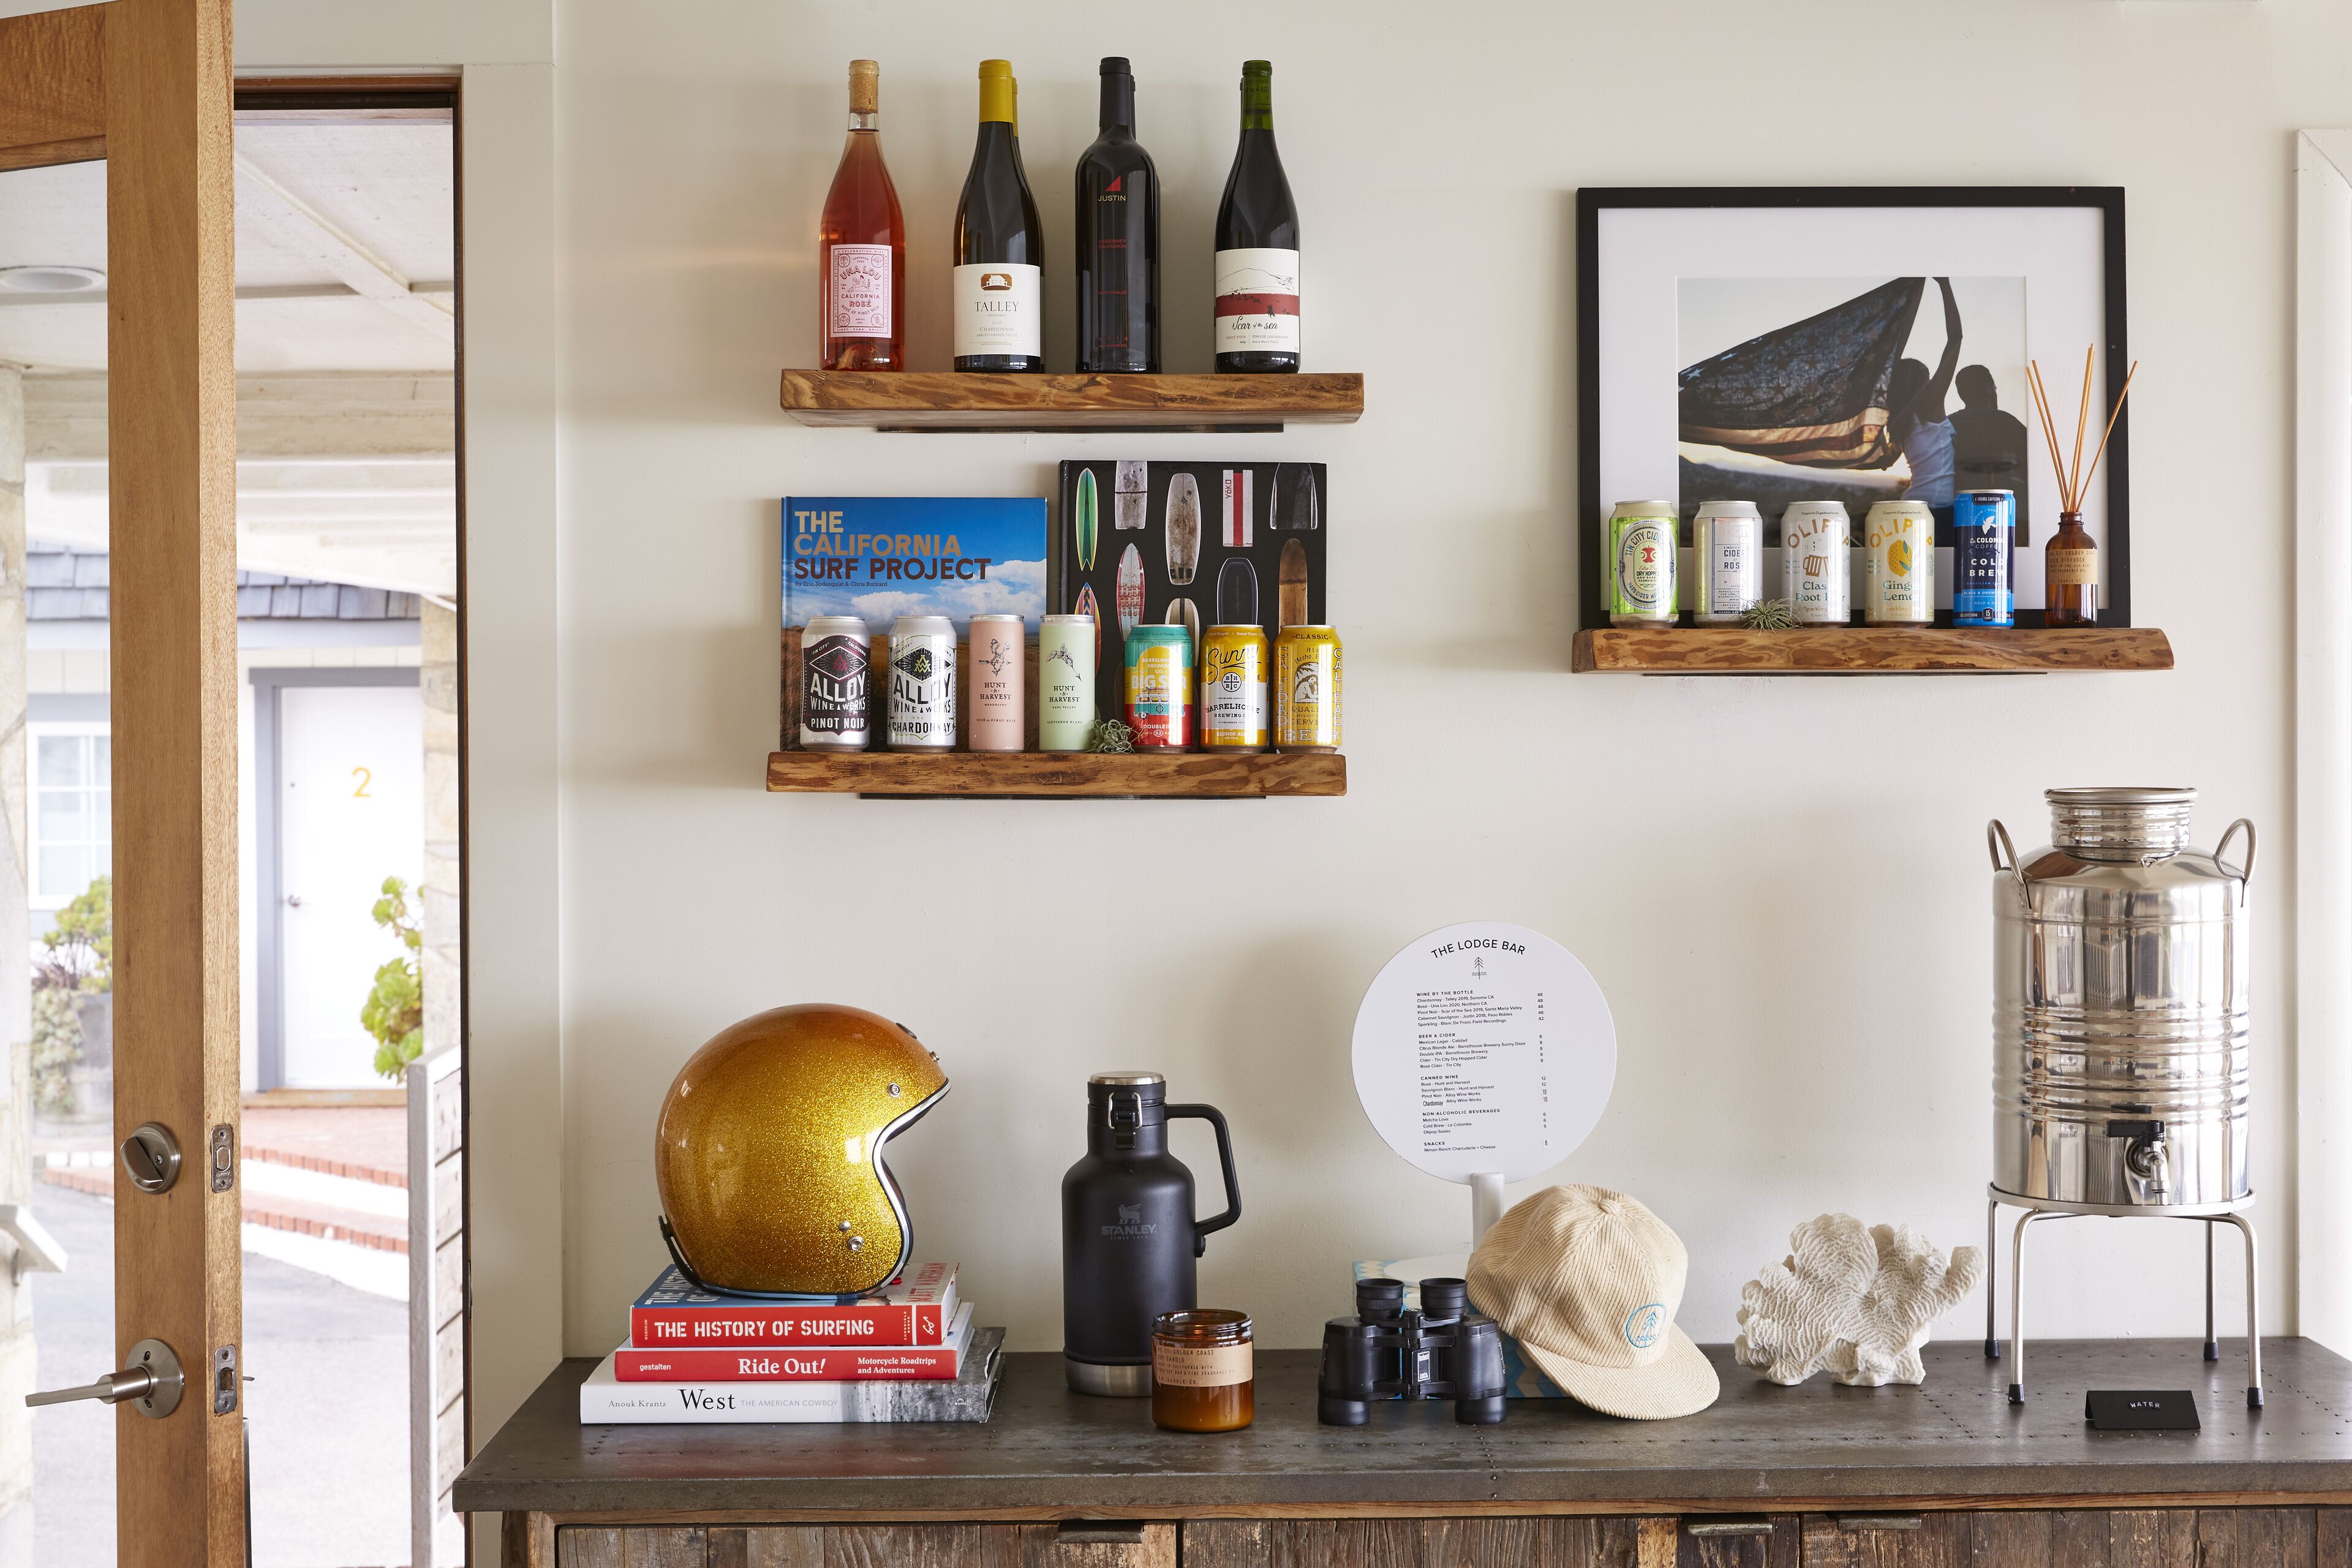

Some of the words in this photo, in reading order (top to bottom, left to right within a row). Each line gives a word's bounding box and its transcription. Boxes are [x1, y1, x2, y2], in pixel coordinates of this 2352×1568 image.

[840, 266, 861, 279] UNA
[862, 266, 881, 280] LOU
[850, 299, 871, 307] ROSÉ
[975, 301, 1019, 312] TALLEY
[1232, 315, 1251, 330] Scar
[794, 511, 843, 533] THE
[1631, 531, 1645, 545] CITY
[1646, 531, 1662, 545] CIDE
[1788, 519, 1850, 549] OLIPP
[1870, 518, 1932, 549] OLIPP
[794, 534, 961, 557] CALIFORNIA
[794, 558, 859, 579] SURF
[870, 558, 992, 580] PROJECT
[1883, 581, 1915, 591] Ginge
[1795, 593, 1821, 601] Root
[810, 671, 866, 702] ALLOY
[1131, 675, 1156, 689] BIG
[1276, 647, 1289, 726] CALIDAD
[1333, 648, 1342, 726] CALIDAD
[810, 696, 835, 710] WINE
[843, 696, 865, 710] WORKS
[894, 698, 917, 713] WINE
[1205, 703, 1260, 714] BARRELHOE
[811, 717, 839, 729] PINOT
[843, 717, 864, 729] NOIR
[892, 722, 951, 734] CHARDOAY
[352, 766, 371, 797] 2
[1431, 943, 1455, 959] THE
[1458, 939, 1498, 950] LODGE
[1501, 941, 1525, 955] BAR
[1101, 1224, 1156, 1235] STANLEY
[654, 1322, 687, 1337] THE
[695, 1321, 766, 1337] HISTORY
[772, 1321, 794, 1336] OF
[801, 1319, 874, 1336] SURFING
[738, 1359, 780, 1374] Ride
[784, 1358, 826, 1374] Out!
[858, 1357, 899, 1366] Motorcycle
[677, 1389, 736, 1410] West
